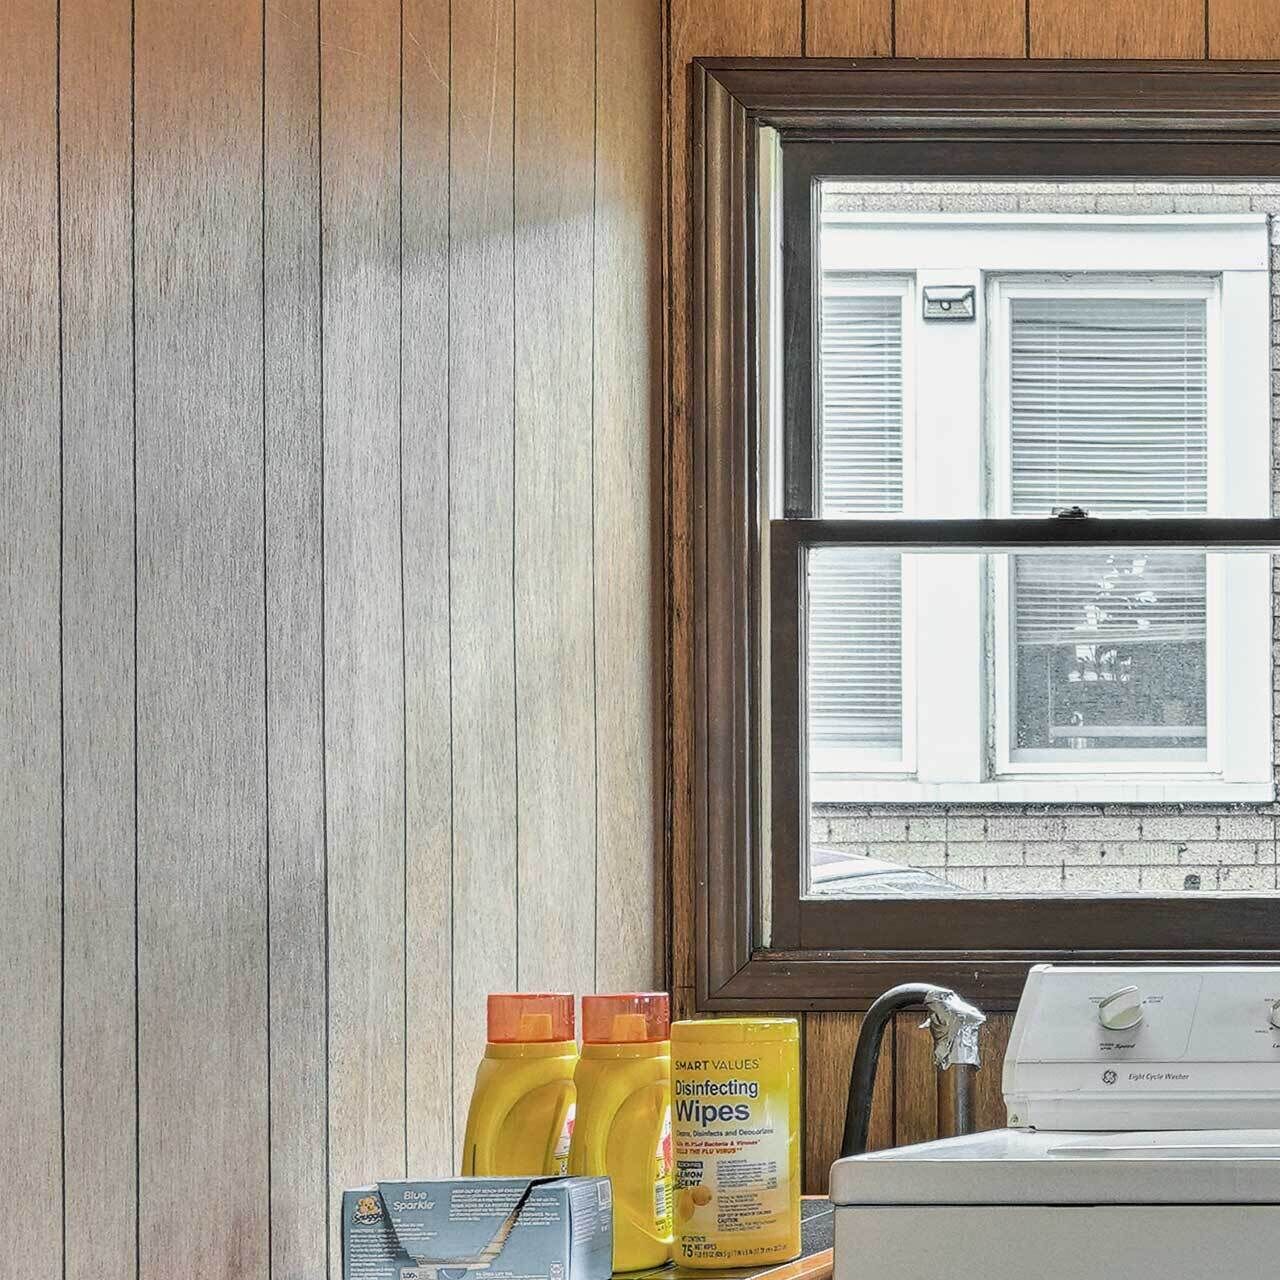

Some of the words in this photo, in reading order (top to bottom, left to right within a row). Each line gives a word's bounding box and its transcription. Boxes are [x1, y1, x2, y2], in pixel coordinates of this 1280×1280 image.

[675, 1060, 709, 1070] SMART
[712, 1059, 759, 1070] VALUES
[1128, 1073, 1144, 1081] Eight
[1146, 1073, 1164, 1081] Cycle
[675, 1080, 758, 1098] Disinfecting
[676, 1100, 750, 1128] Wipes
[403, 1191, 428, 1200] Blue
[682, 1244, 693, 1258] 75
